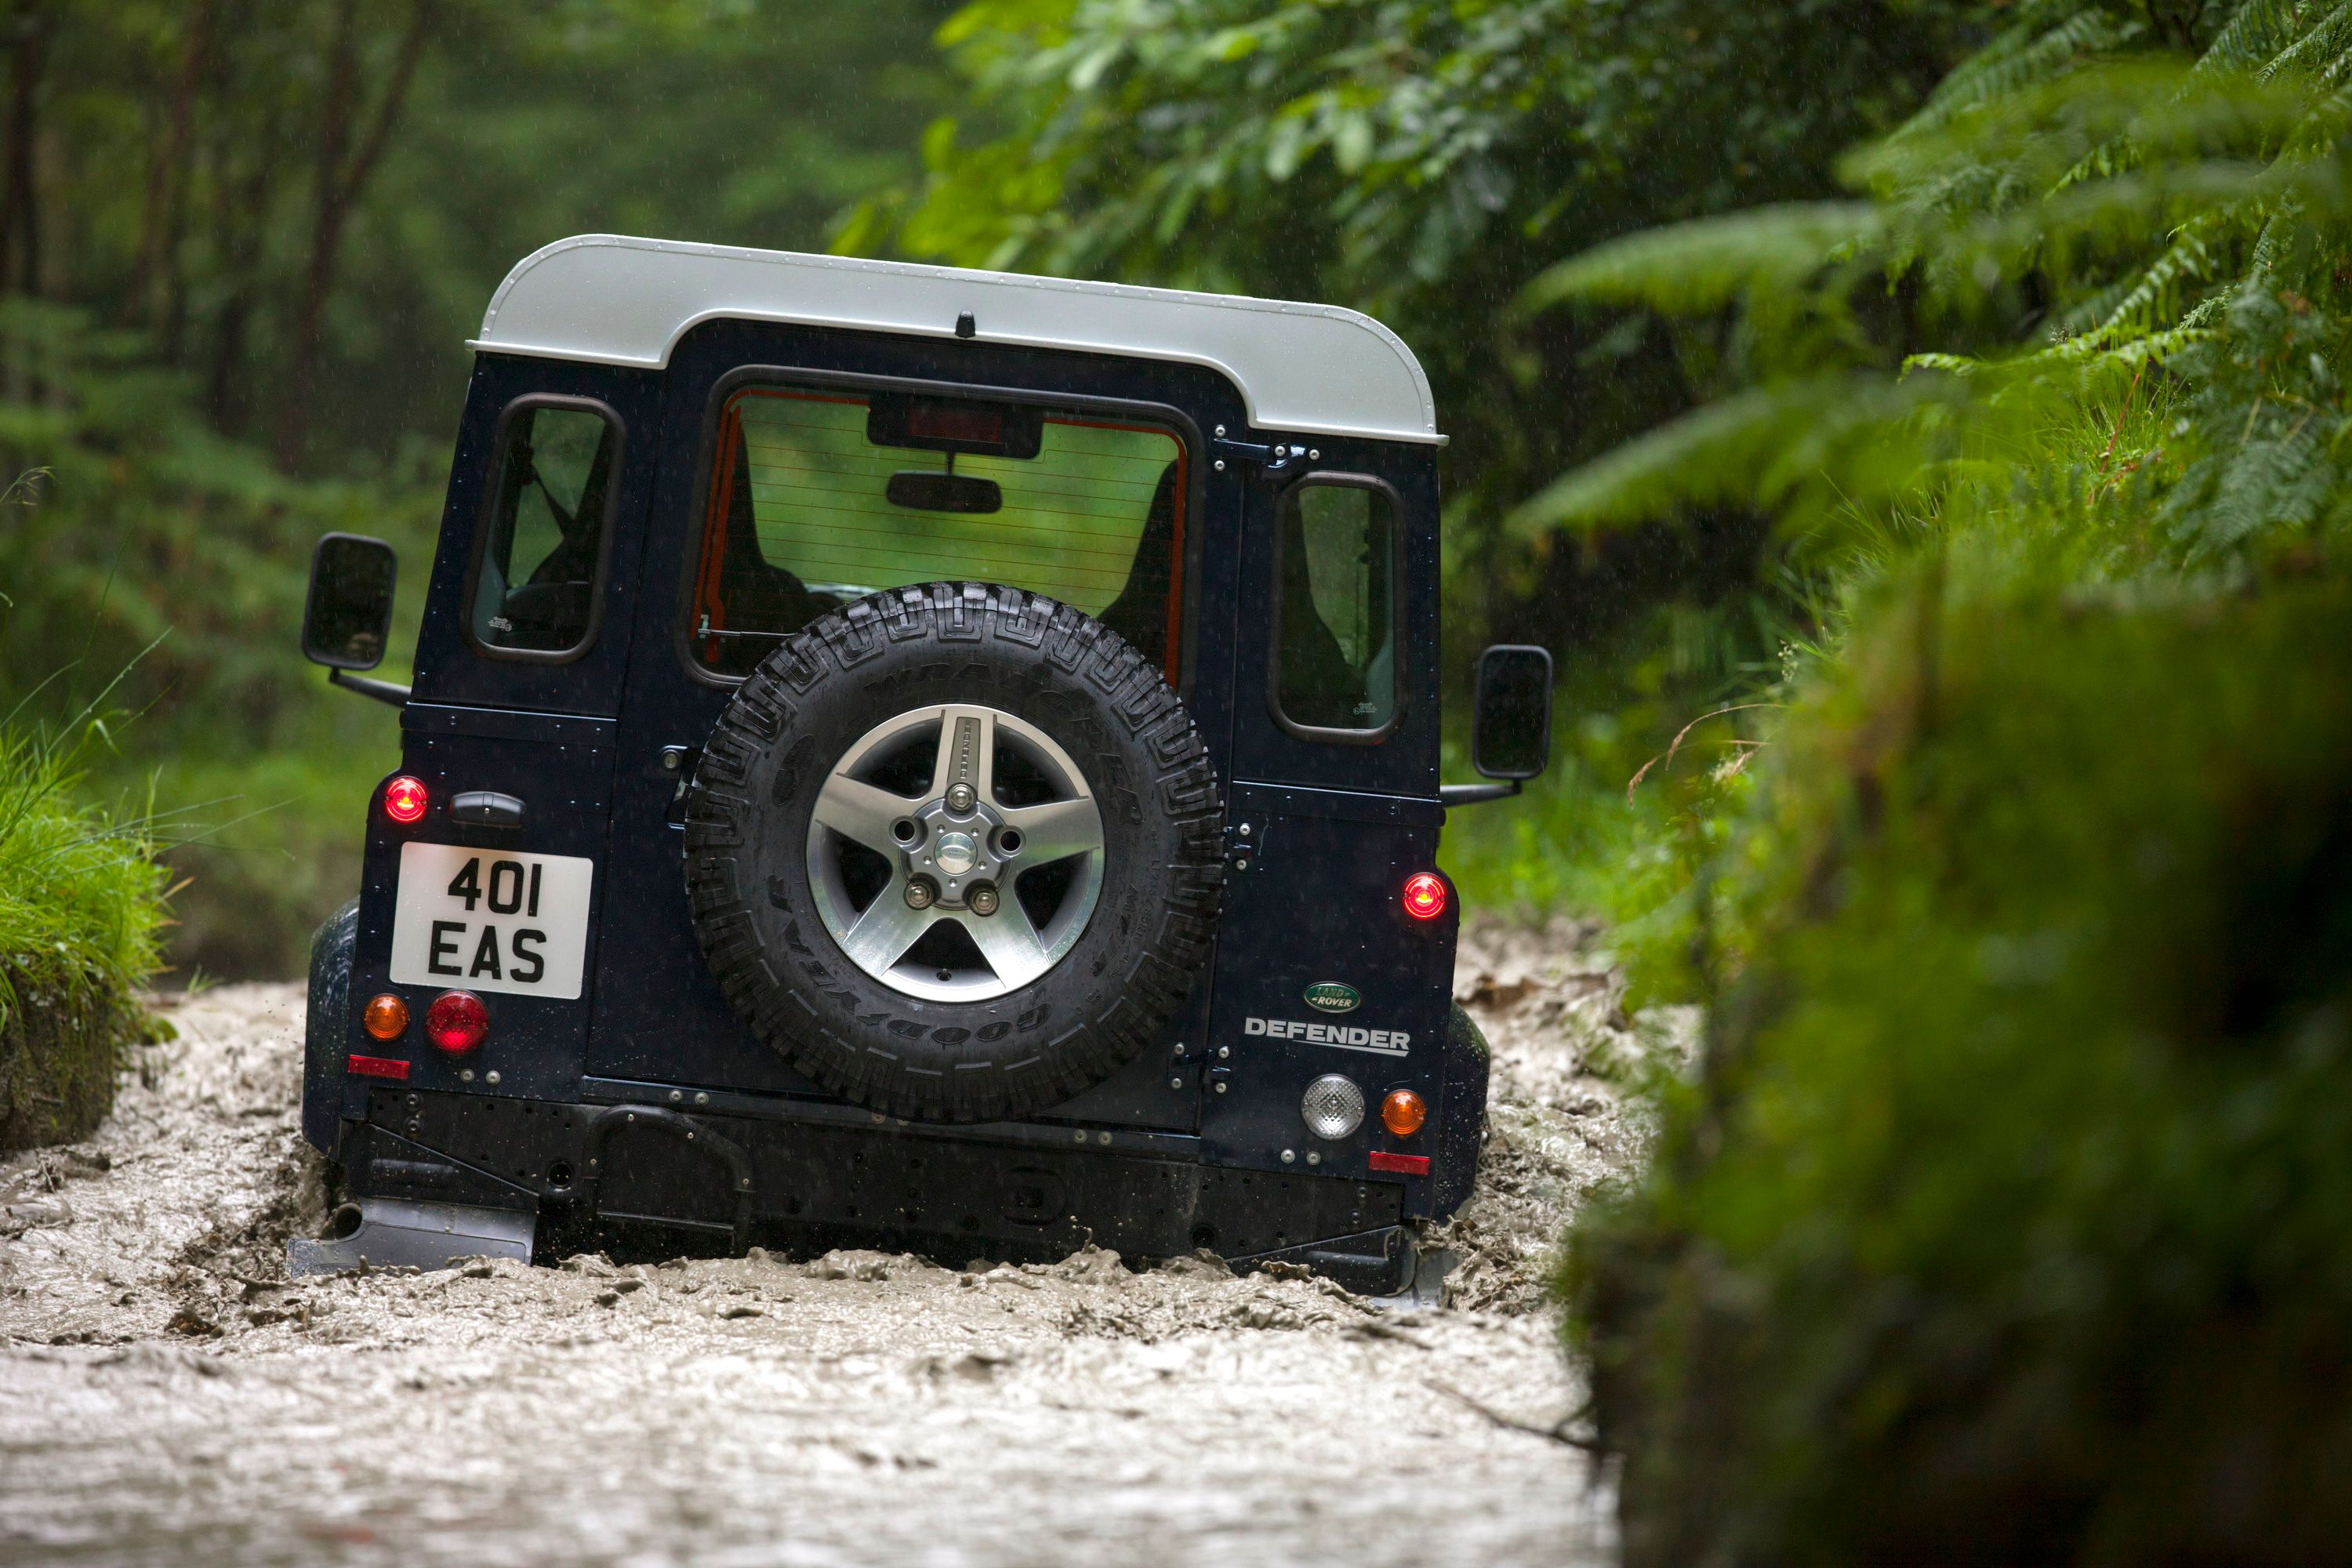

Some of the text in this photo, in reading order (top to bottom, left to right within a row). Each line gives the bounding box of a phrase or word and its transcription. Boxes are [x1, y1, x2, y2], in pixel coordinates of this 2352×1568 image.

[960, 720, 972, 779] DEFENDER
[448, 857, 542, 916] 401
[428, 920, 546, 983] EAS
[1316, 986, 1345, 998] LAND
[1317, 996, 1352, 1007] ROVER
[1244, 1018, 1410, 1050] DEFENDER
